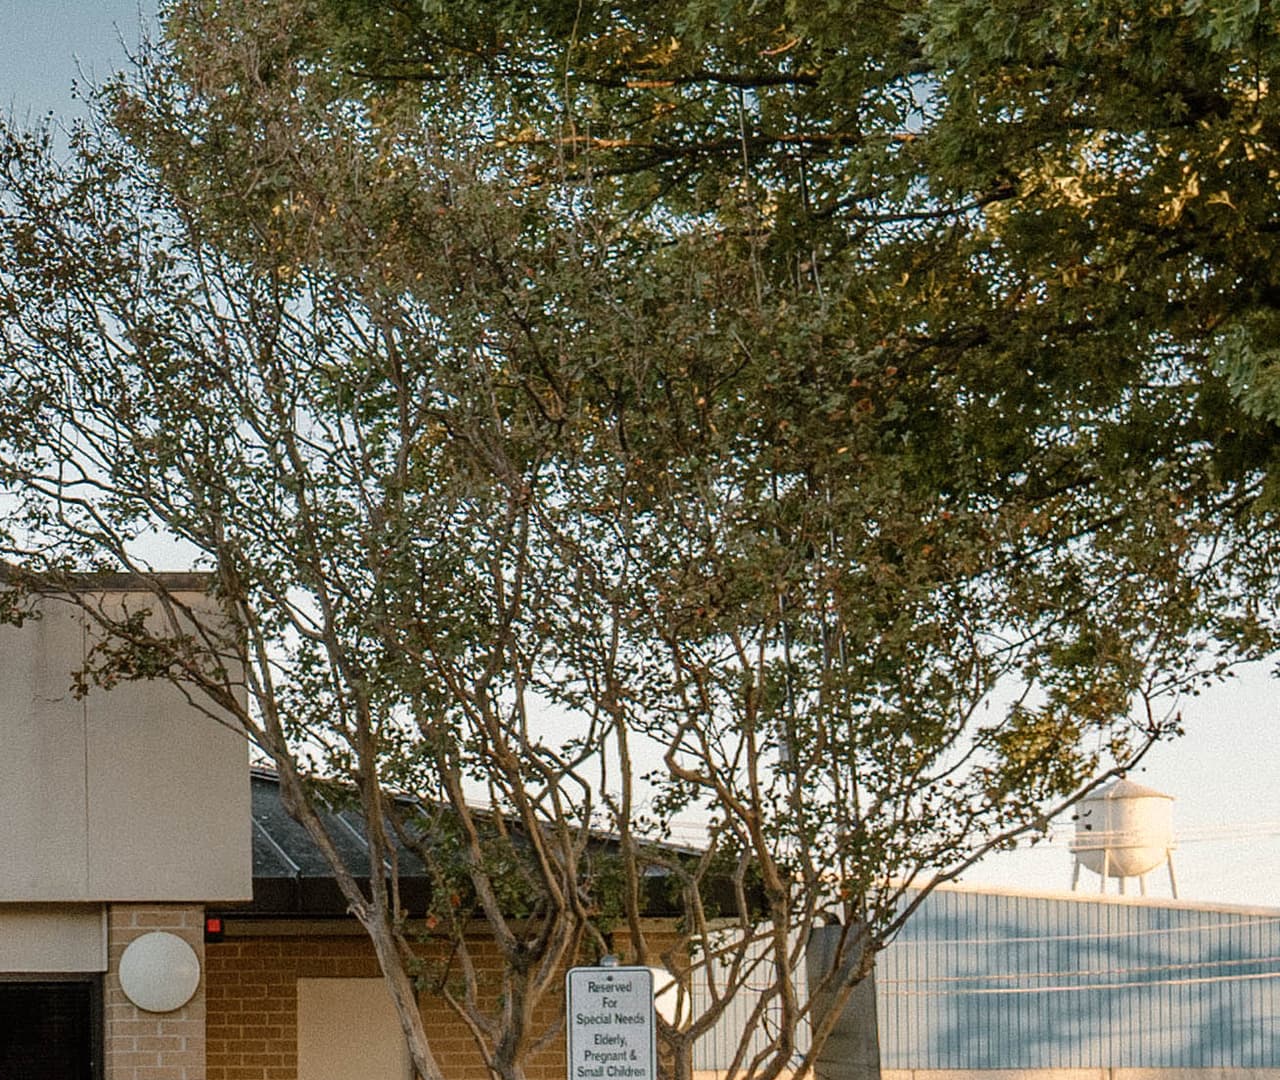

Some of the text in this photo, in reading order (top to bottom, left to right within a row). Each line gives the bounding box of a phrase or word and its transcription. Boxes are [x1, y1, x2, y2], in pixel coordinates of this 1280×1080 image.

[588, 981, 632, 993] Reserved
[602, 997, 618, 1008] For
[576, 1013, 645, 1026] Special Needs
[584, 1050, 627, 1064] Pregnant
[577, 1066, 645, 1077] Small Children
